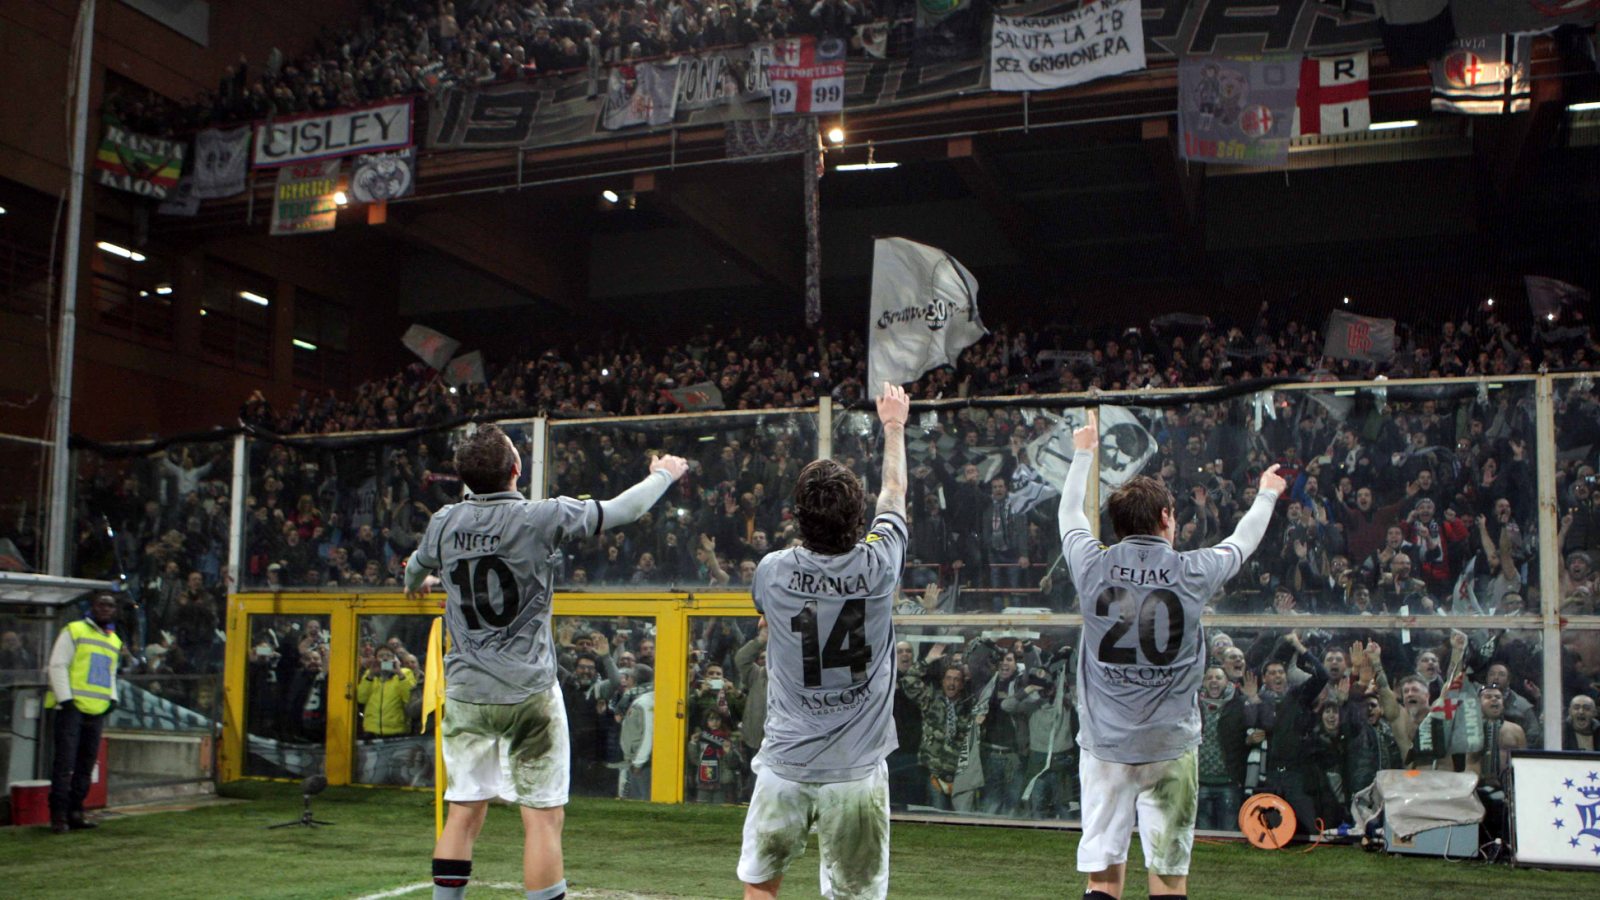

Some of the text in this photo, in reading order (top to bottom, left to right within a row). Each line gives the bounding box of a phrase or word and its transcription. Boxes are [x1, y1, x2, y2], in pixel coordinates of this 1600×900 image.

[994, 30, 1054, 51] SALUTA
[1064, 25, 1087, 44] LA
[994, 35, 1131, 73] SEZ GRIGIONERA
[768, 65, 844, 79] SUPPORTERS
[1333, 58, 1356, 80] R
[788, 571, 870, 596] BRANCA
[1110, 564, 1171, 586] CELJAK
[451, 554, 519, 630] 10
[1095, 586, 1185, 666] 20
[791, 598, 872, 688] 14
[1104, 666, 1173, 681] ASCOM
